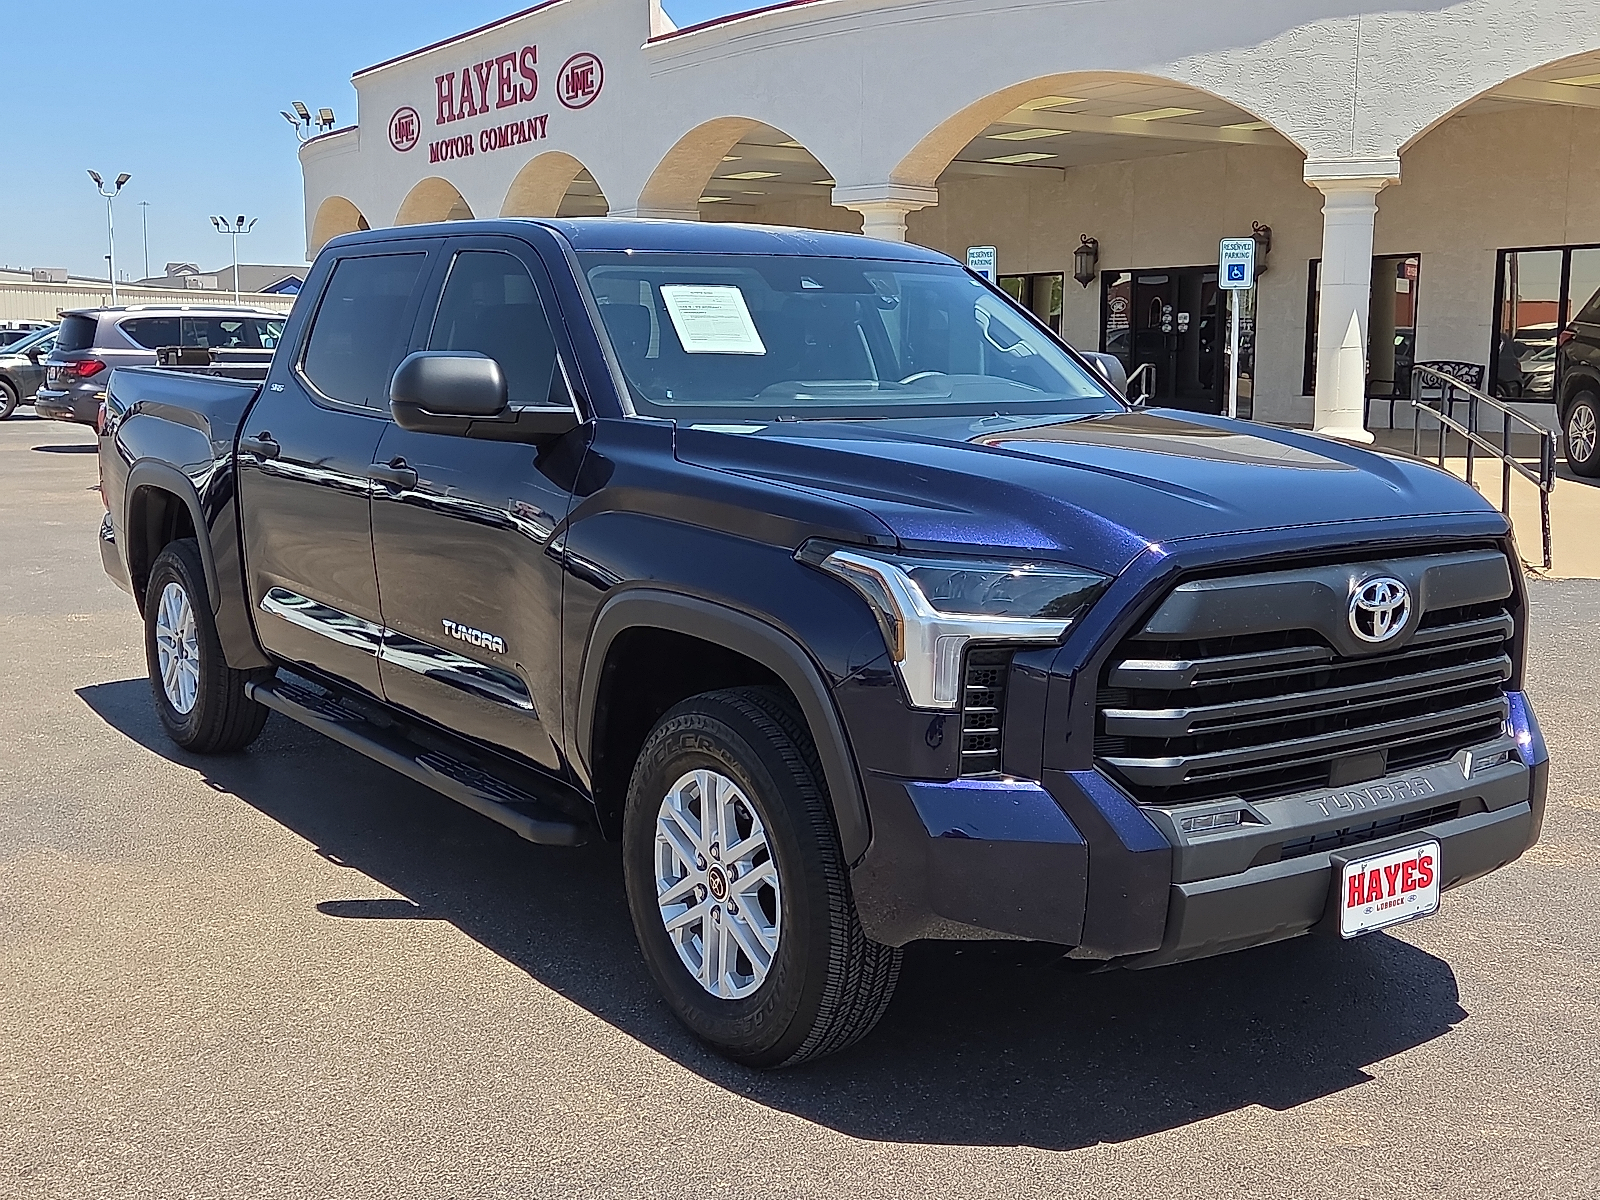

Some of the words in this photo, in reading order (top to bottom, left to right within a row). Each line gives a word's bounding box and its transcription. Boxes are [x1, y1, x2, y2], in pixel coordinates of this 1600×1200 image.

[435, 44, 538, 125] HAYES
[429, 134, 474, 164] MOTOR
[480, 114, 549, 153] COMPANY
[1223, 243, 1252, 251] RESERVED
[441, 618, 504, 654] TUNDRA
[1306, 776, 1435, 816] TUNDRA
[1347, 855, 1434, 909] HAYES
[1376, 897, 1405, 911] LUBBOCK
